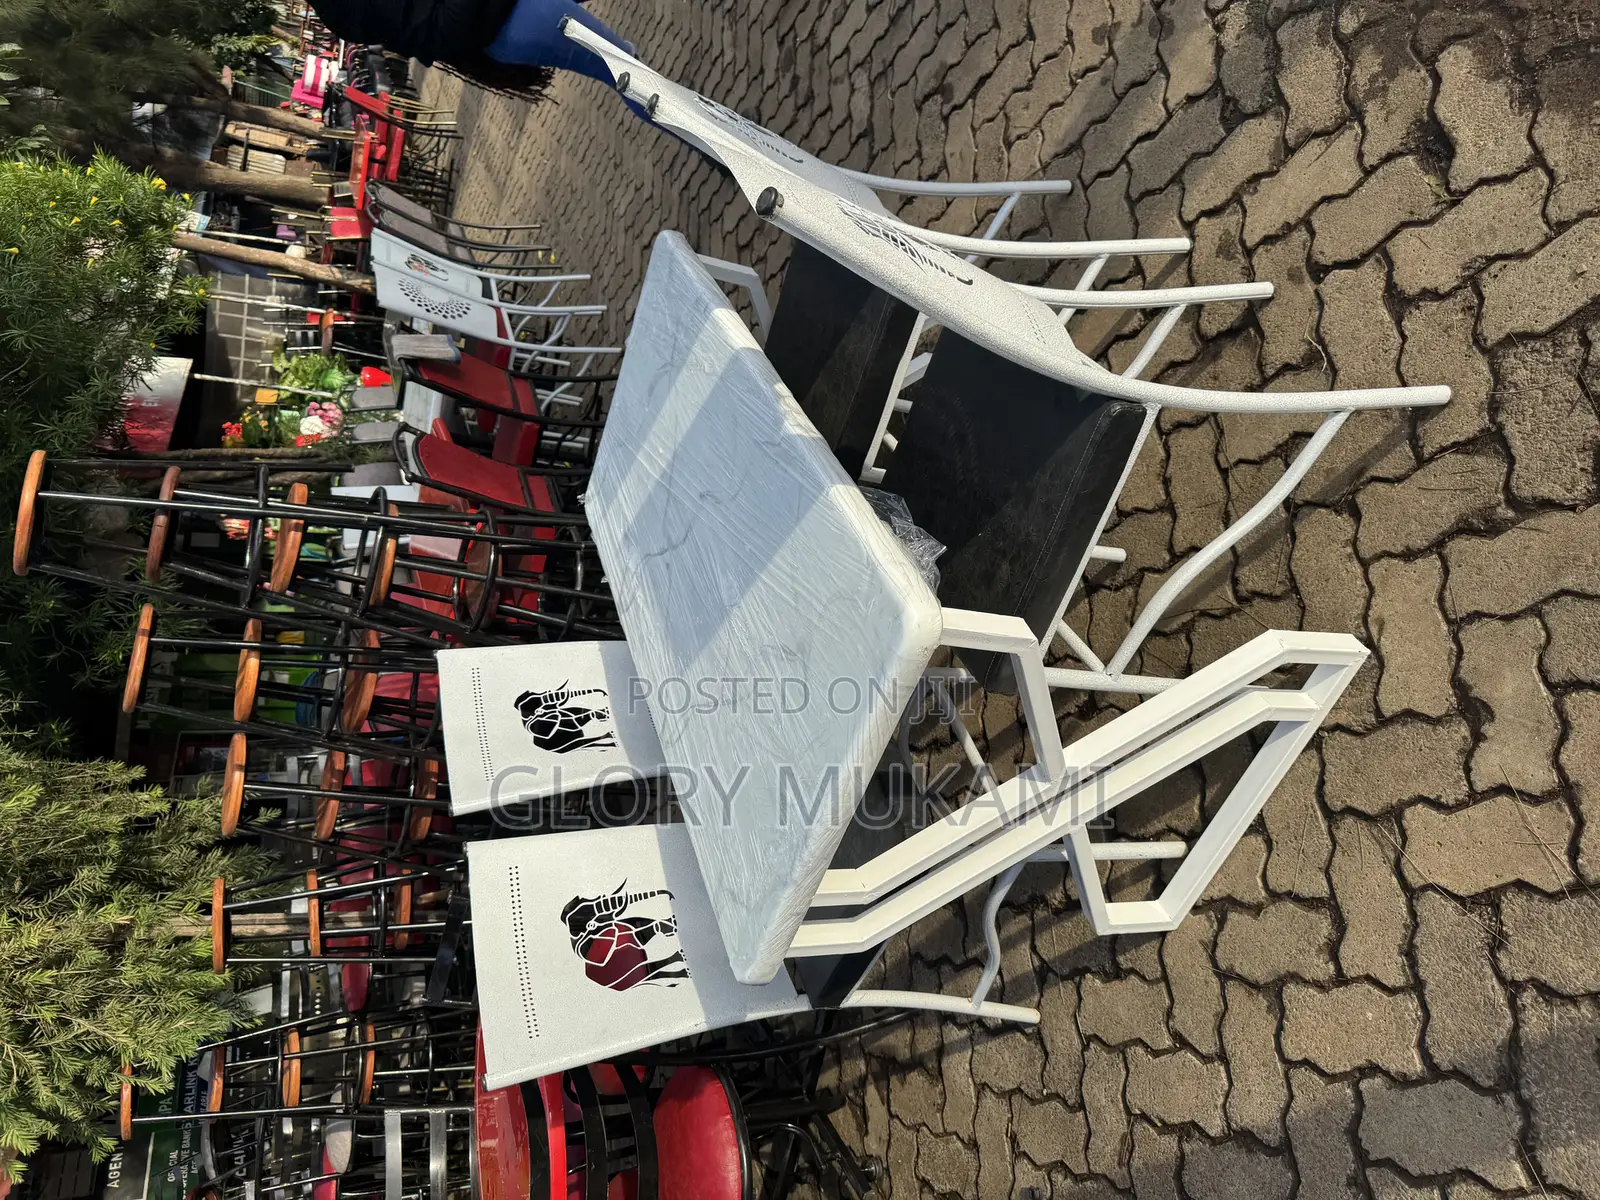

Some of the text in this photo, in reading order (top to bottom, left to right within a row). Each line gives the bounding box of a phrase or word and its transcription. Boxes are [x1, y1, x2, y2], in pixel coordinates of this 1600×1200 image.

[181, 1069, 198, 1129] SARLINK
[167, 1148, 179, 1182] OFCIAL
[190, 1149, 199, 1173] AGET
